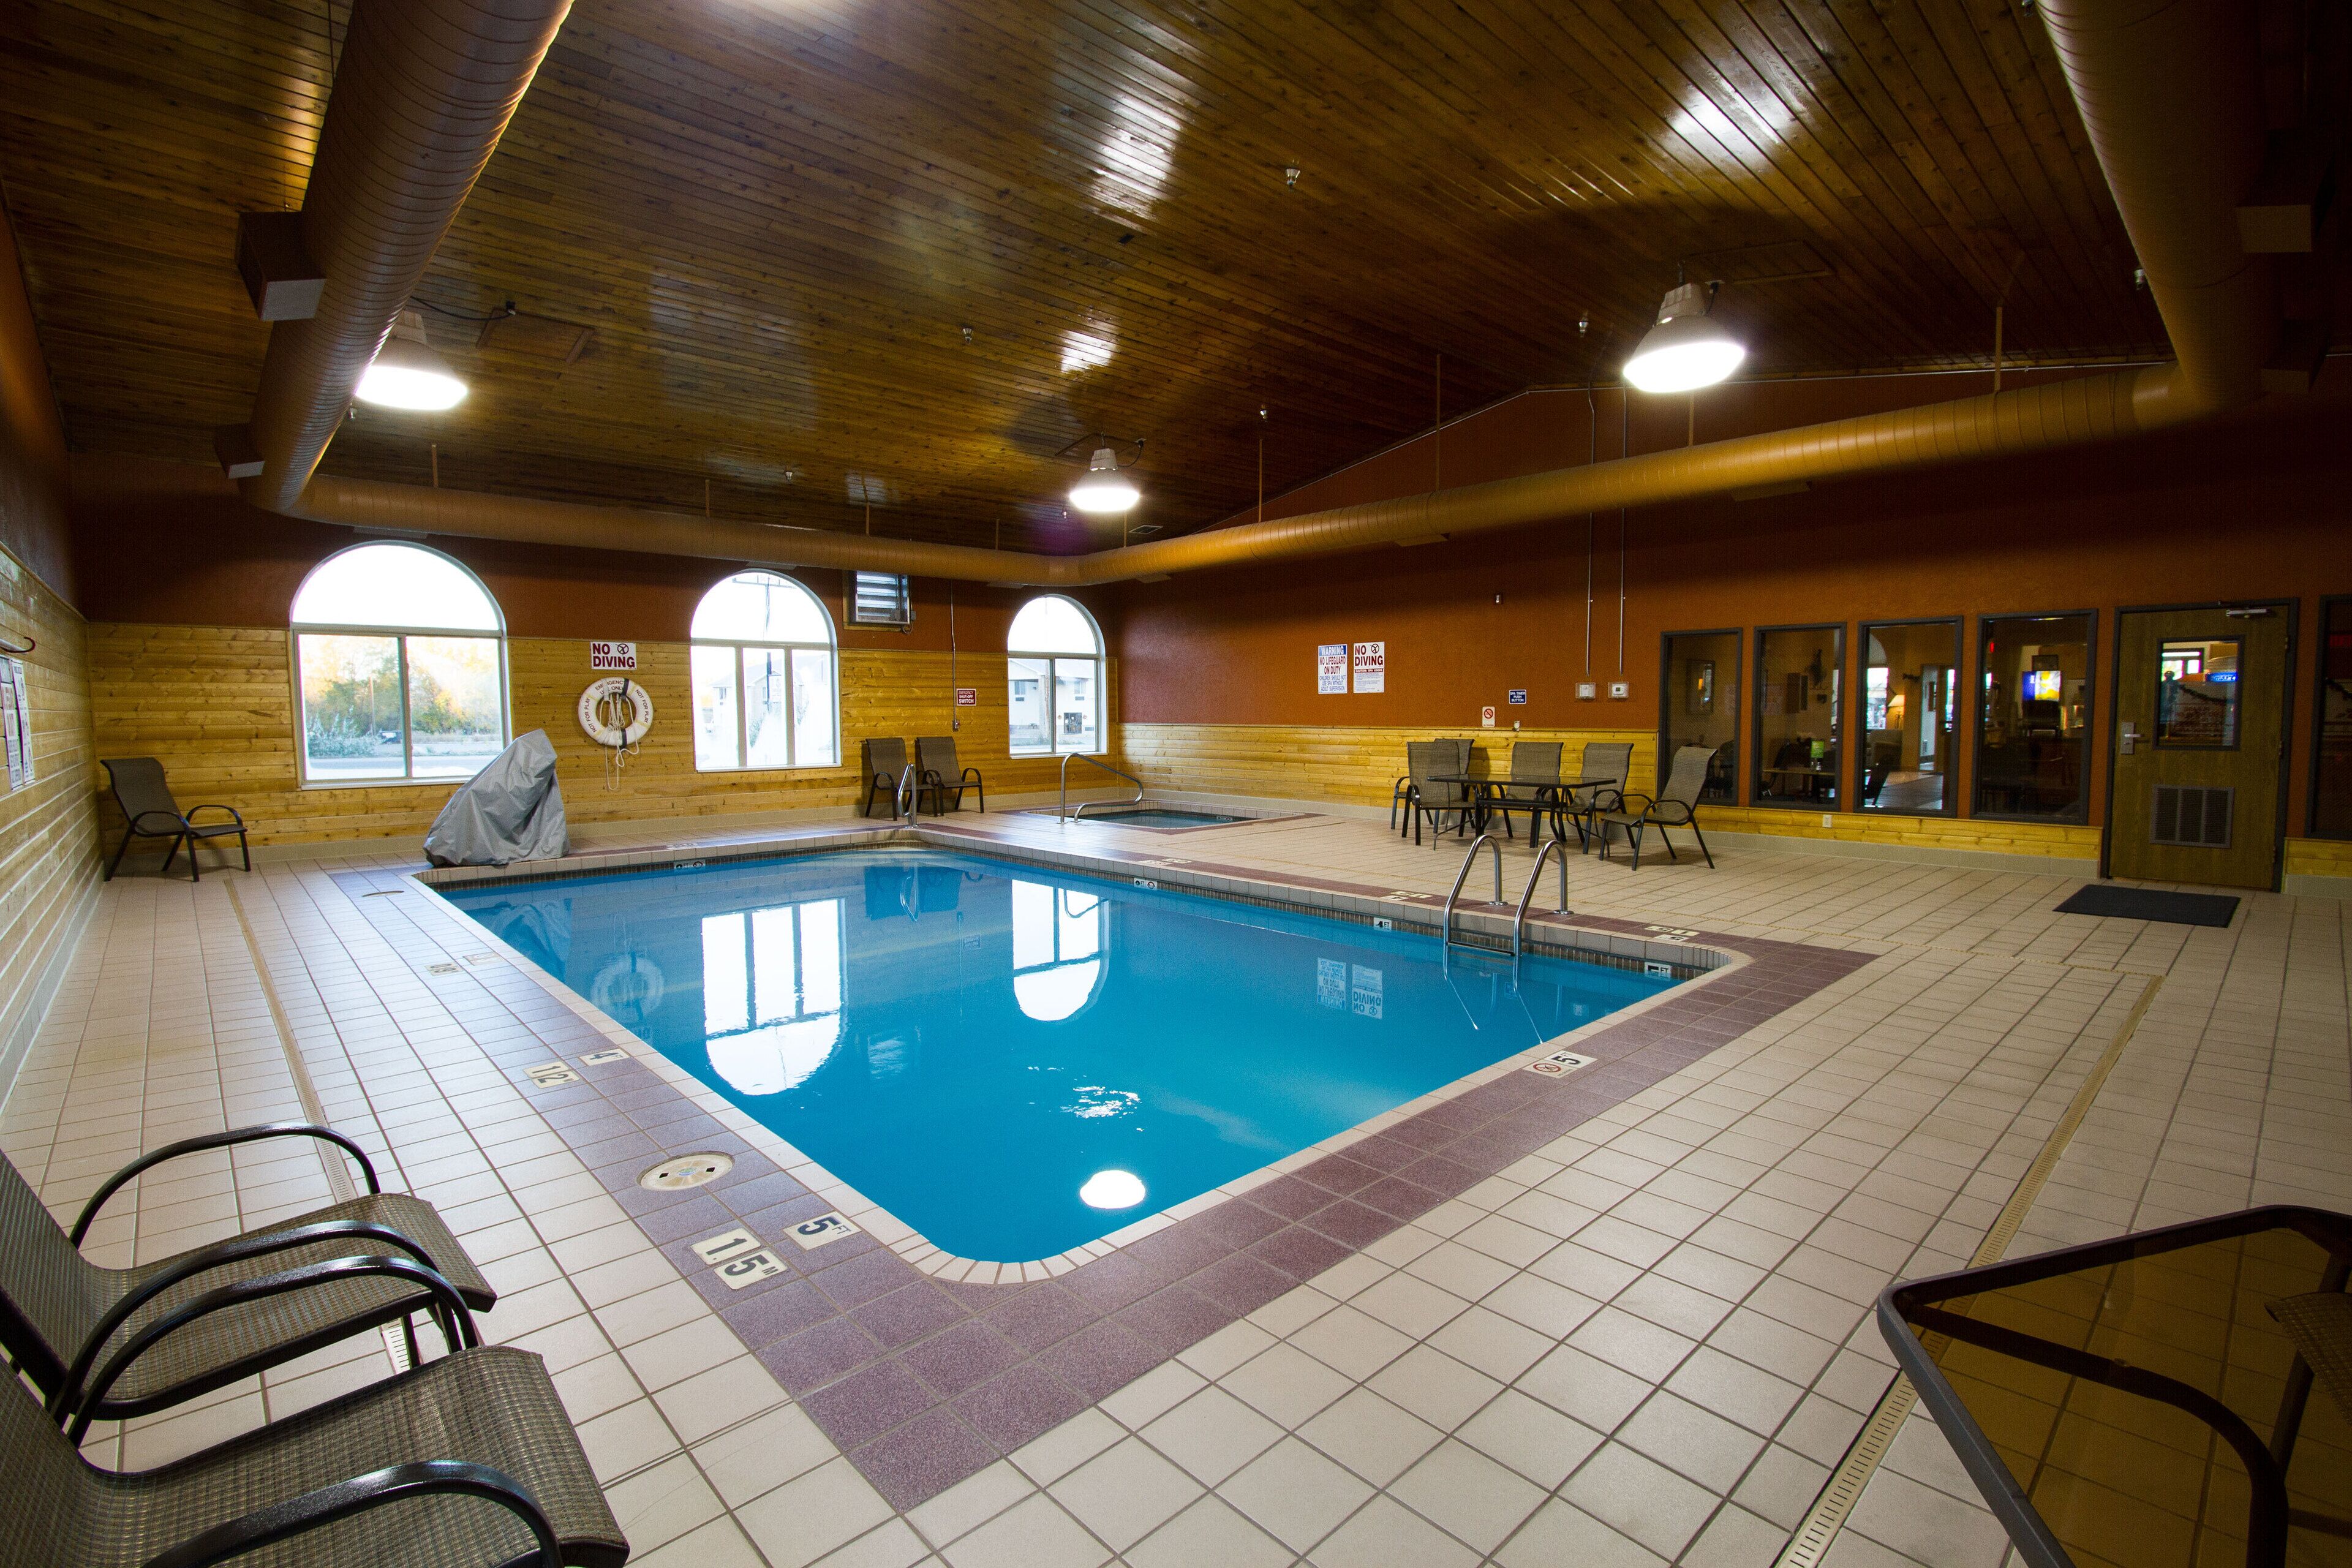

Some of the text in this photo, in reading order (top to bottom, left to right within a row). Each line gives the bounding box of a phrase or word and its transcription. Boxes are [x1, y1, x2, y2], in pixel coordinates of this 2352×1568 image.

[592, 644, 610, 654] NO
[1321, 646, 1344, 655] WARNING
[1354, 645, 1366, 655] NO
[593, 656, 635, 668] DIVING
[1320, 656, 1346, 665] NO LIFEGUARD
[1354, 655, 1383, 666] DIVING
[1324, 666, 1341, 674] ON DUTY
[635, 689, 644, 698] NOT
[588, 723, 597, 733] NOT
[1551, 1055, 1581, 1065] 5
[797, 1216, 851, 1235] 5 FT
[764, 1267, 778, 1276] M
